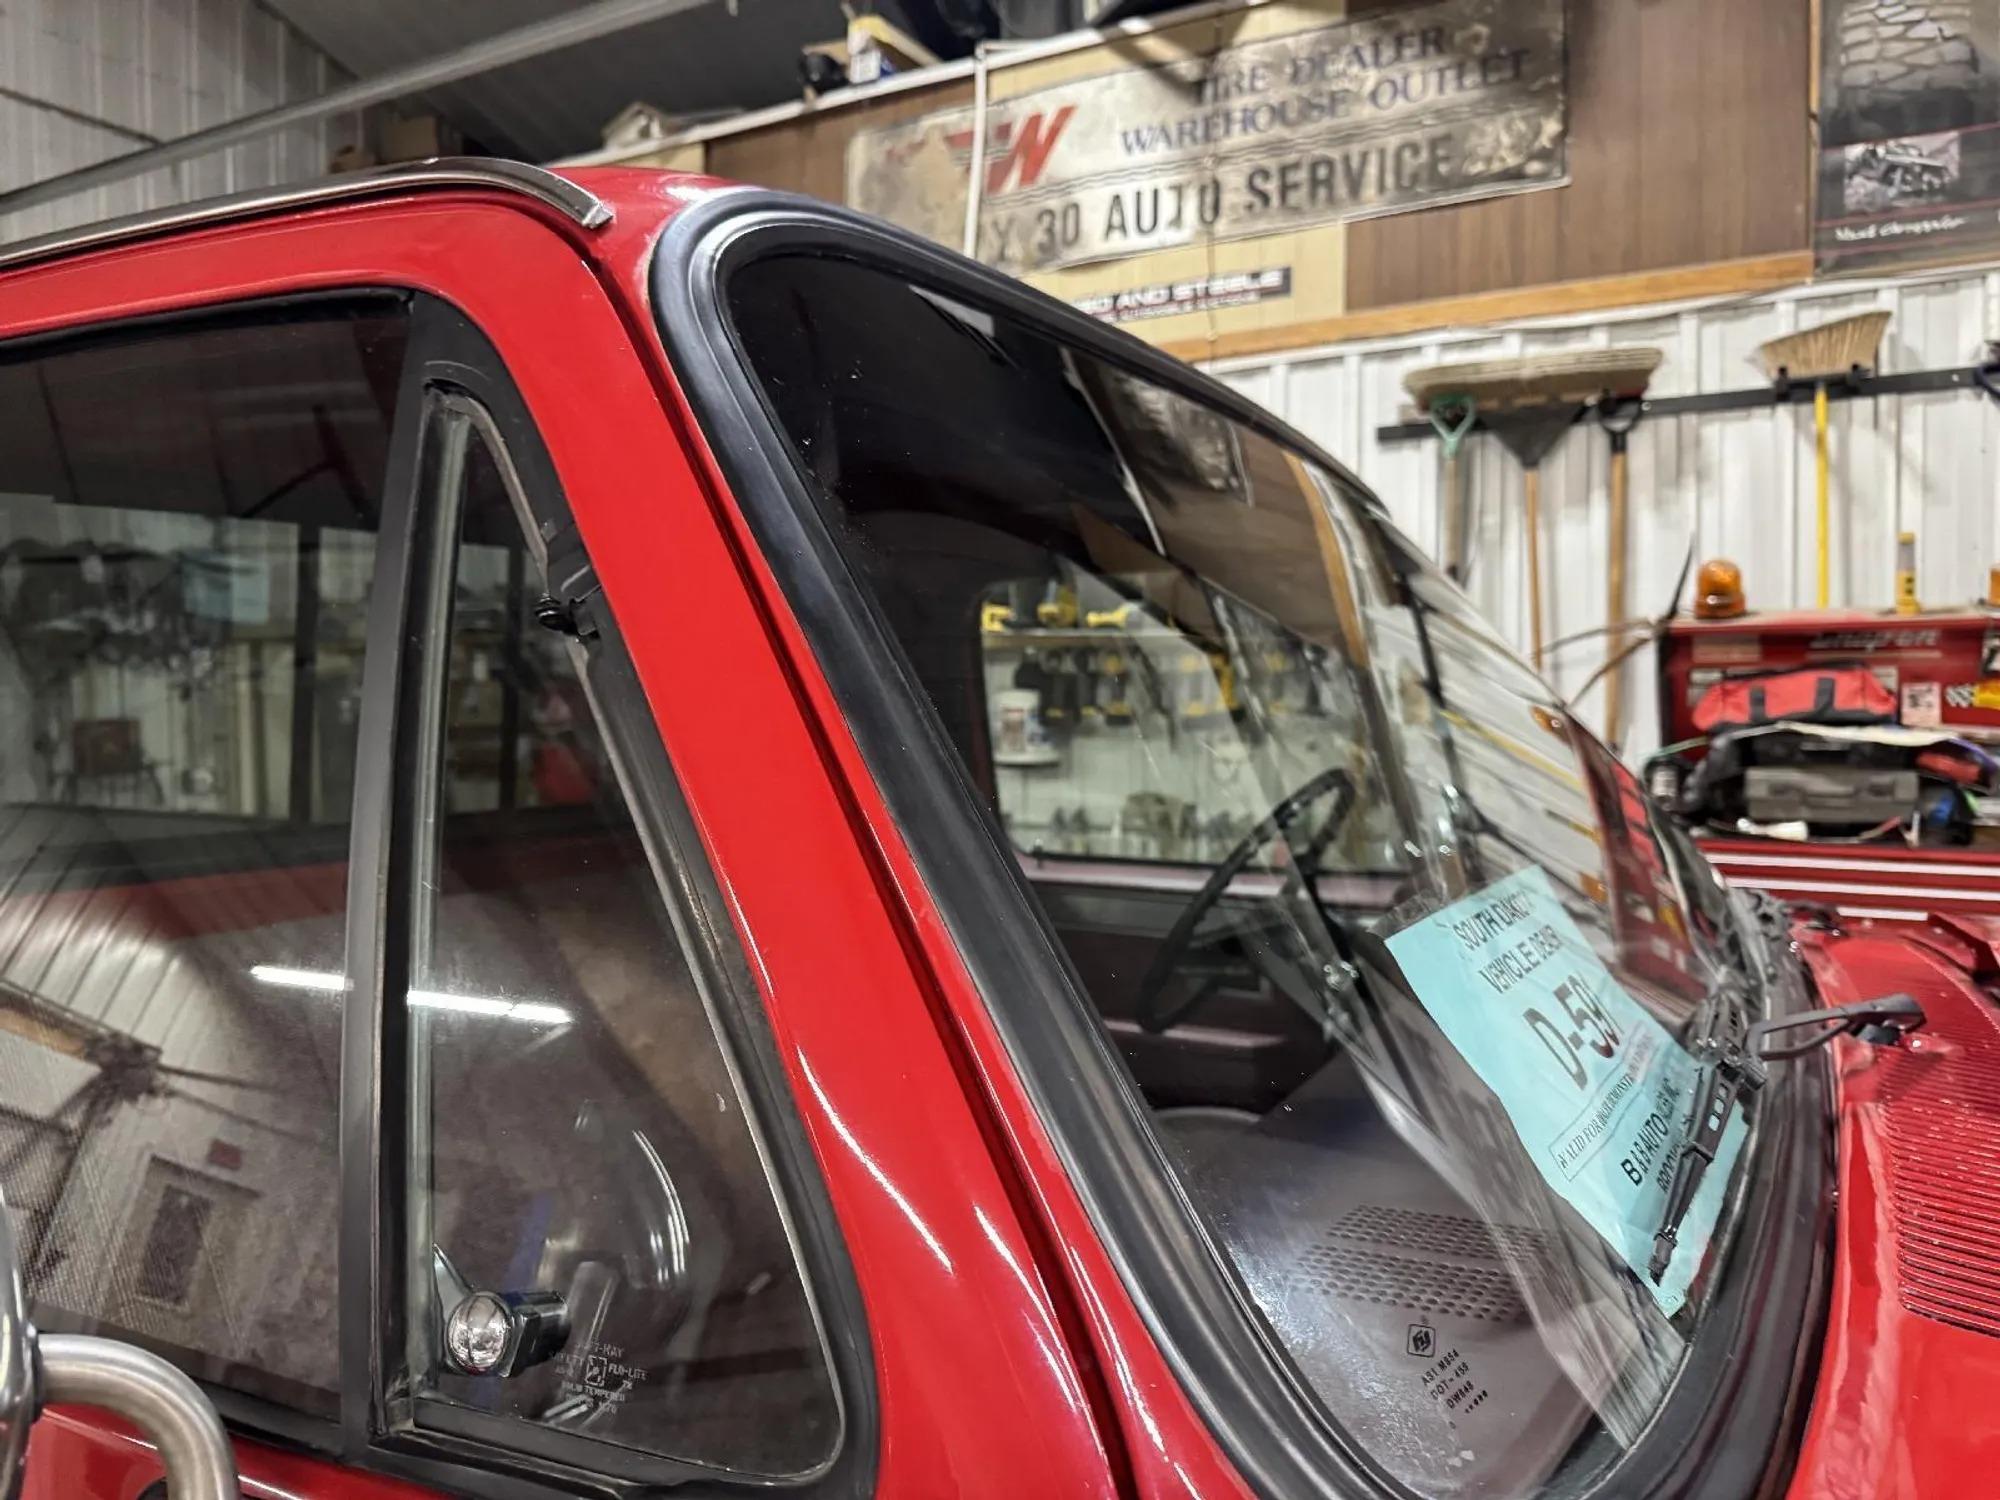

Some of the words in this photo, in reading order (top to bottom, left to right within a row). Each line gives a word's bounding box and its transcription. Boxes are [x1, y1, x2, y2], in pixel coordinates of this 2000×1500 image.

[1290, 25, 1448, 88] DEALER
[1121, 90, 1355, 157] WAREHOUSE
[1371, 50, 1531, 112] OUTLET
[1037, 202, 1082, 257] 30
[1103, 179, 1222, 243] AUTO
[1247, 133, 1455, 210] SERVICE
[1452, 908, 1505, 951] SOUTH
[1477, 941, 1541, 994] VEHICLE
